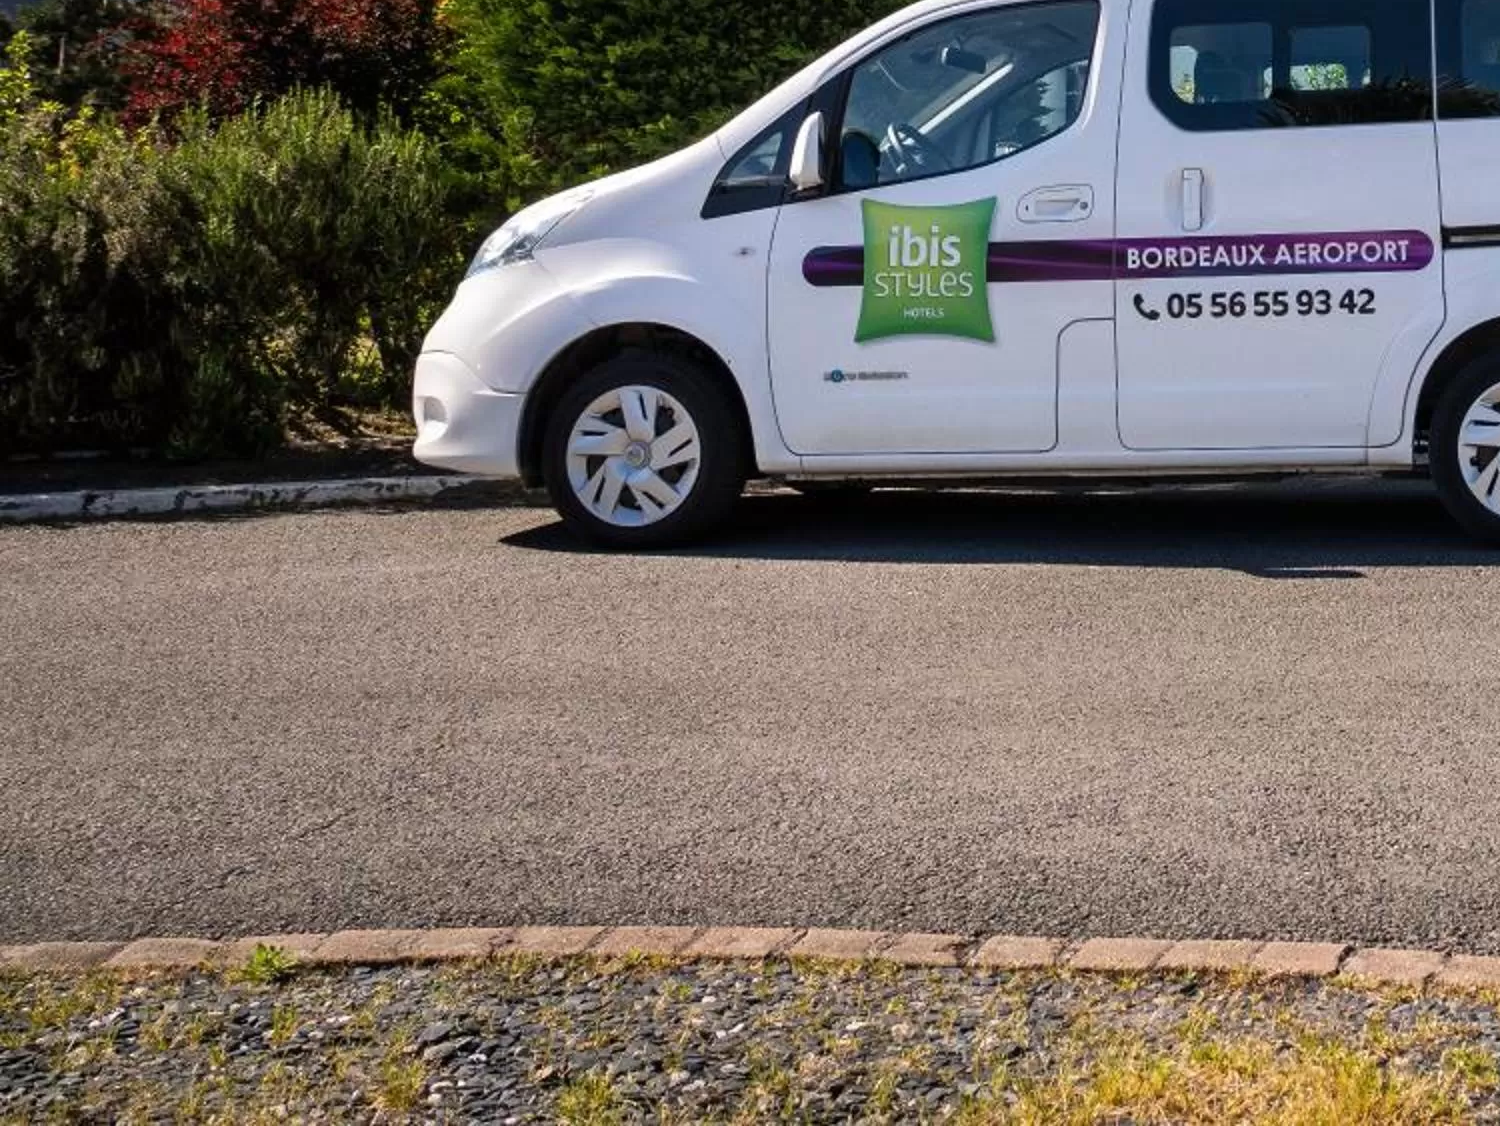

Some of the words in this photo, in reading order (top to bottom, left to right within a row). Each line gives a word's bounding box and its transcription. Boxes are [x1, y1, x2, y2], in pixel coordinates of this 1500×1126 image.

[889, 224, 962, 267] ibis
[1127, 245, 1265, 270] BORDEAUX
[1274, 240, 1409, 265] AEROPORT
[1167, 293, 1203, 318] 05
[1210, 292, 1247, 317] 56
[1253, 291, 1289, 317] 55
[1296, 289, 1332, 315] 93
[1339, 288, 1376, 314] 42
